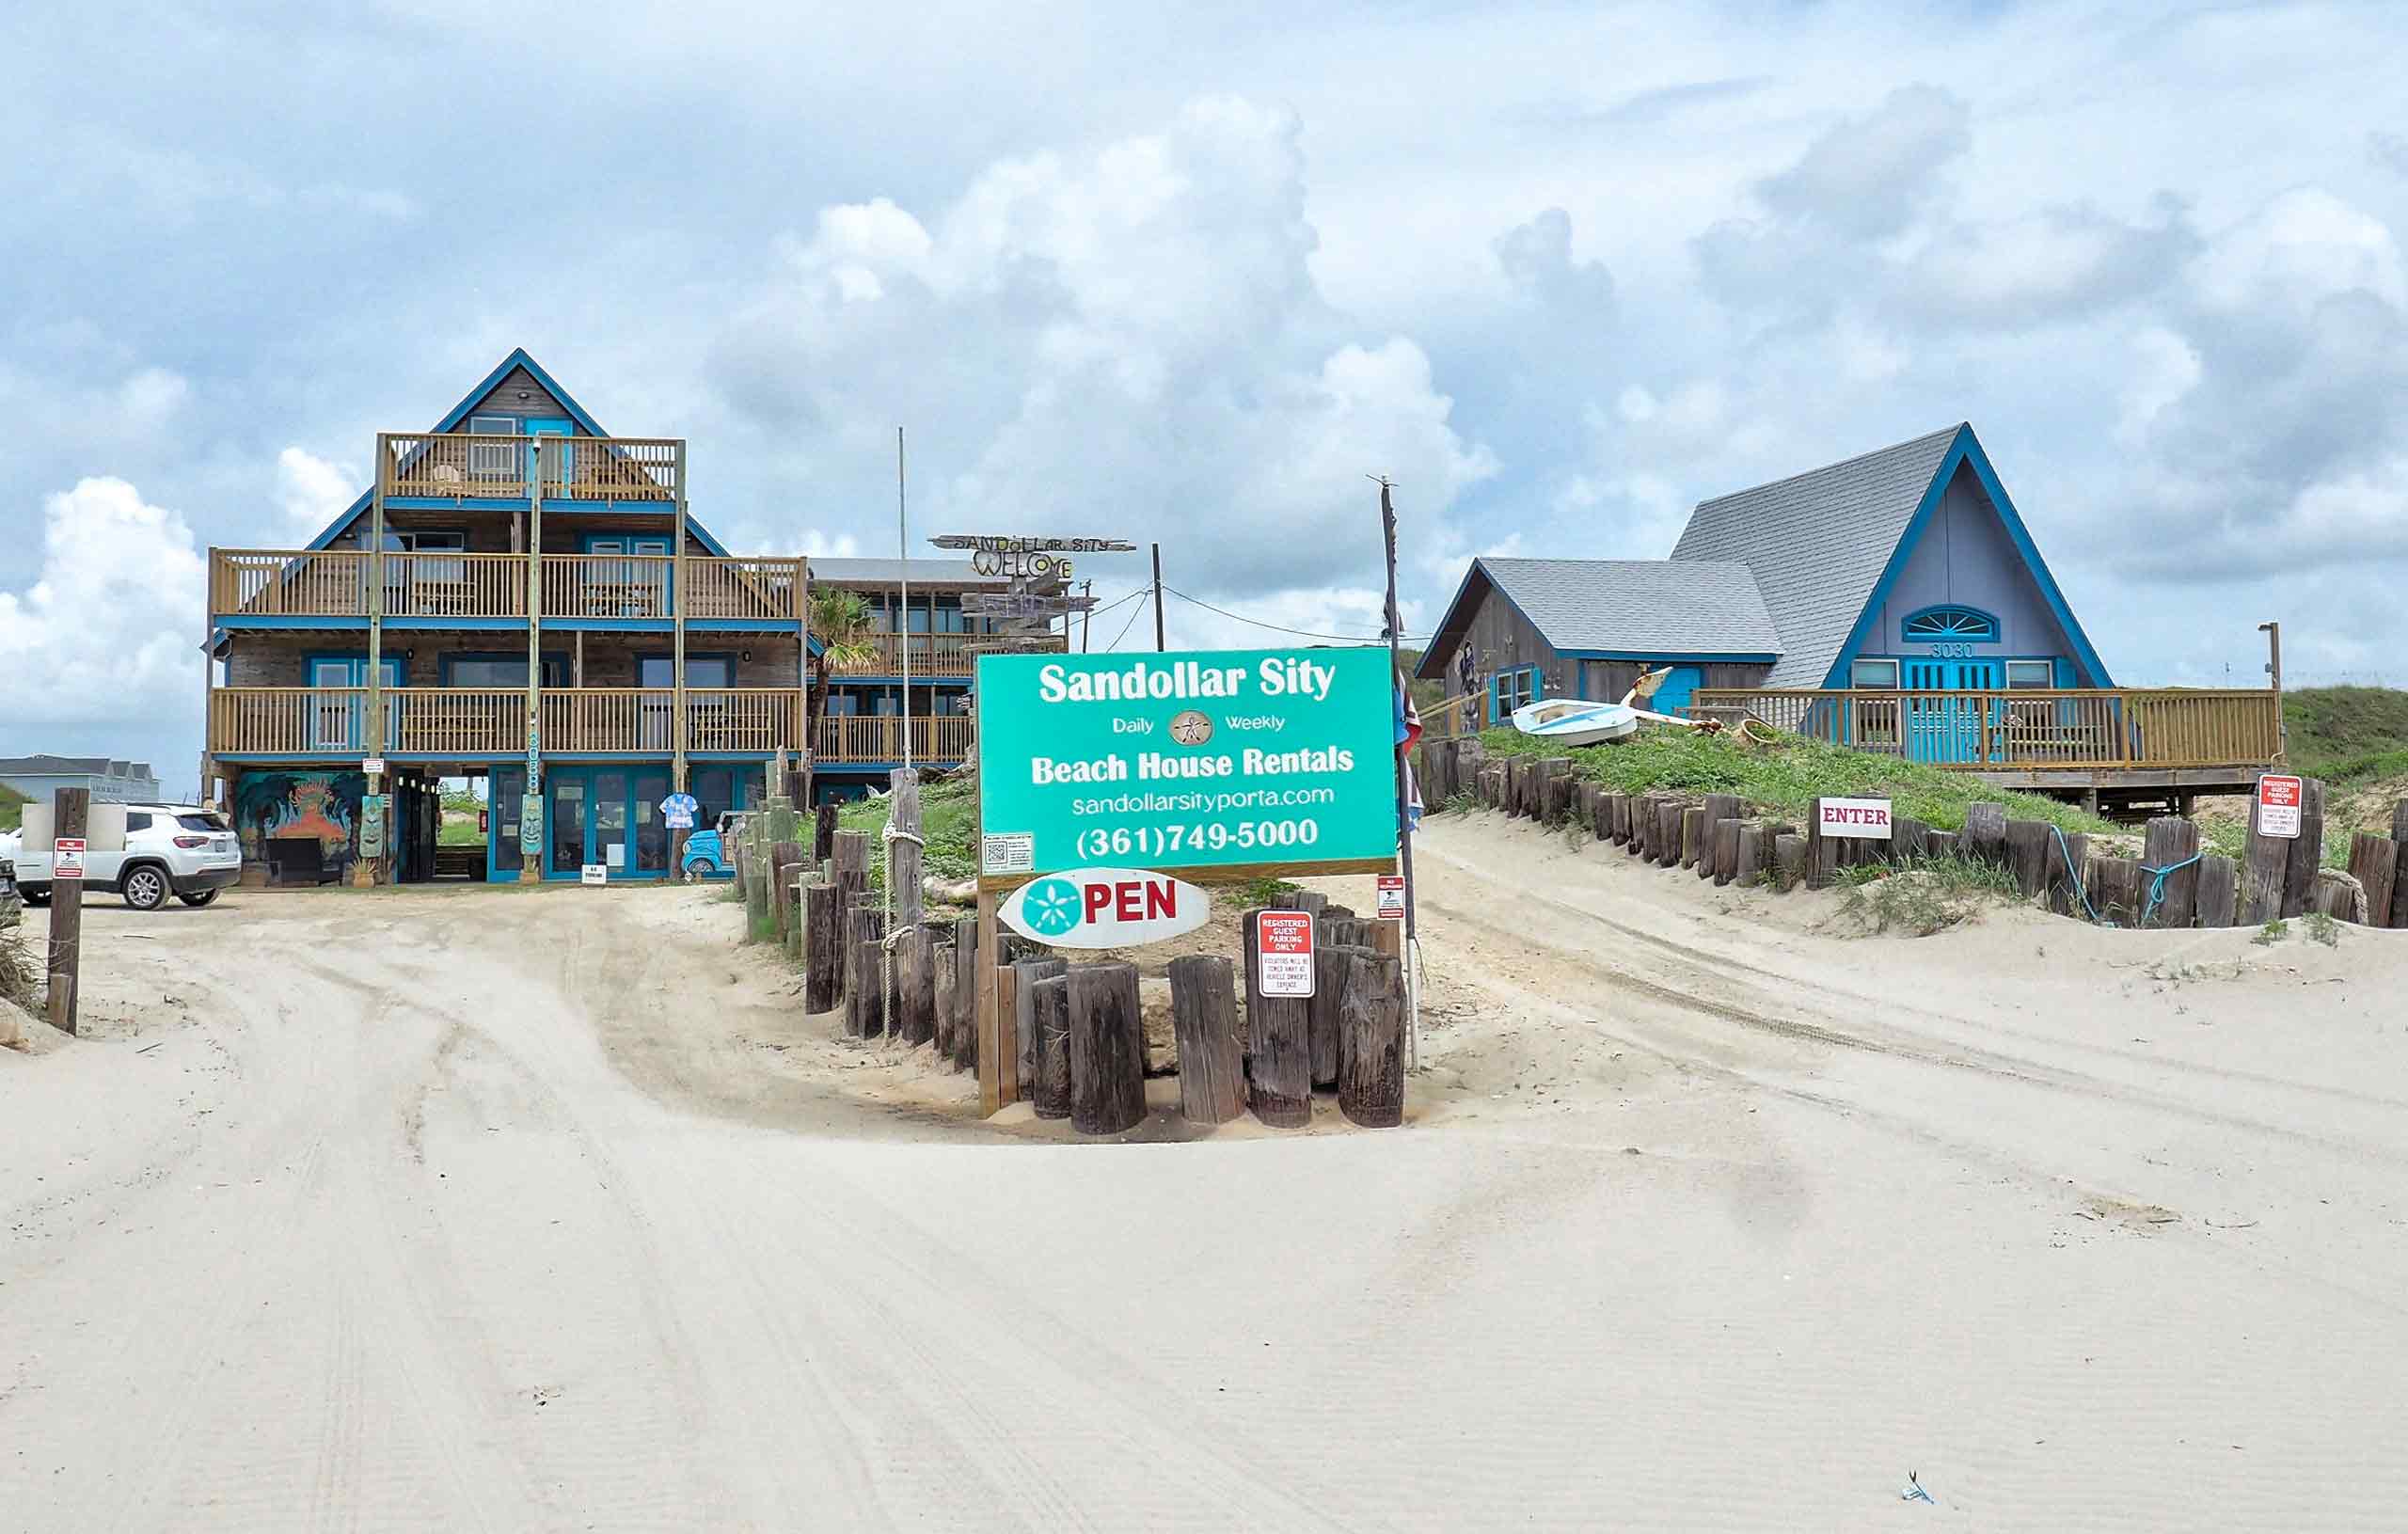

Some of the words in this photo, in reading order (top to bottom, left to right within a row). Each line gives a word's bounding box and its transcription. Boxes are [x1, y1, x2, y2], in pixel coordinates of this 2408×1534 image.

[1932, 642, 1972, 658] 3030
[1038, 661, 1247, 704] Sandollar
[1259, 657, 1336, 701] Sity
[1112, 718, 1154, 735] Daily
[1225, 715, 1286, 733] Weekly
[1032, 754, 1128, 784] Beach
[1138, 751, 1233, 780] House
[1243, 746, 1354, 775] Rentals
[1072, 787, 1334, 816] sandollarsityporta.com
[1823, 807, 1889, 825] ENTER
[1076, 818, 1319, 861] (361)749-5000
